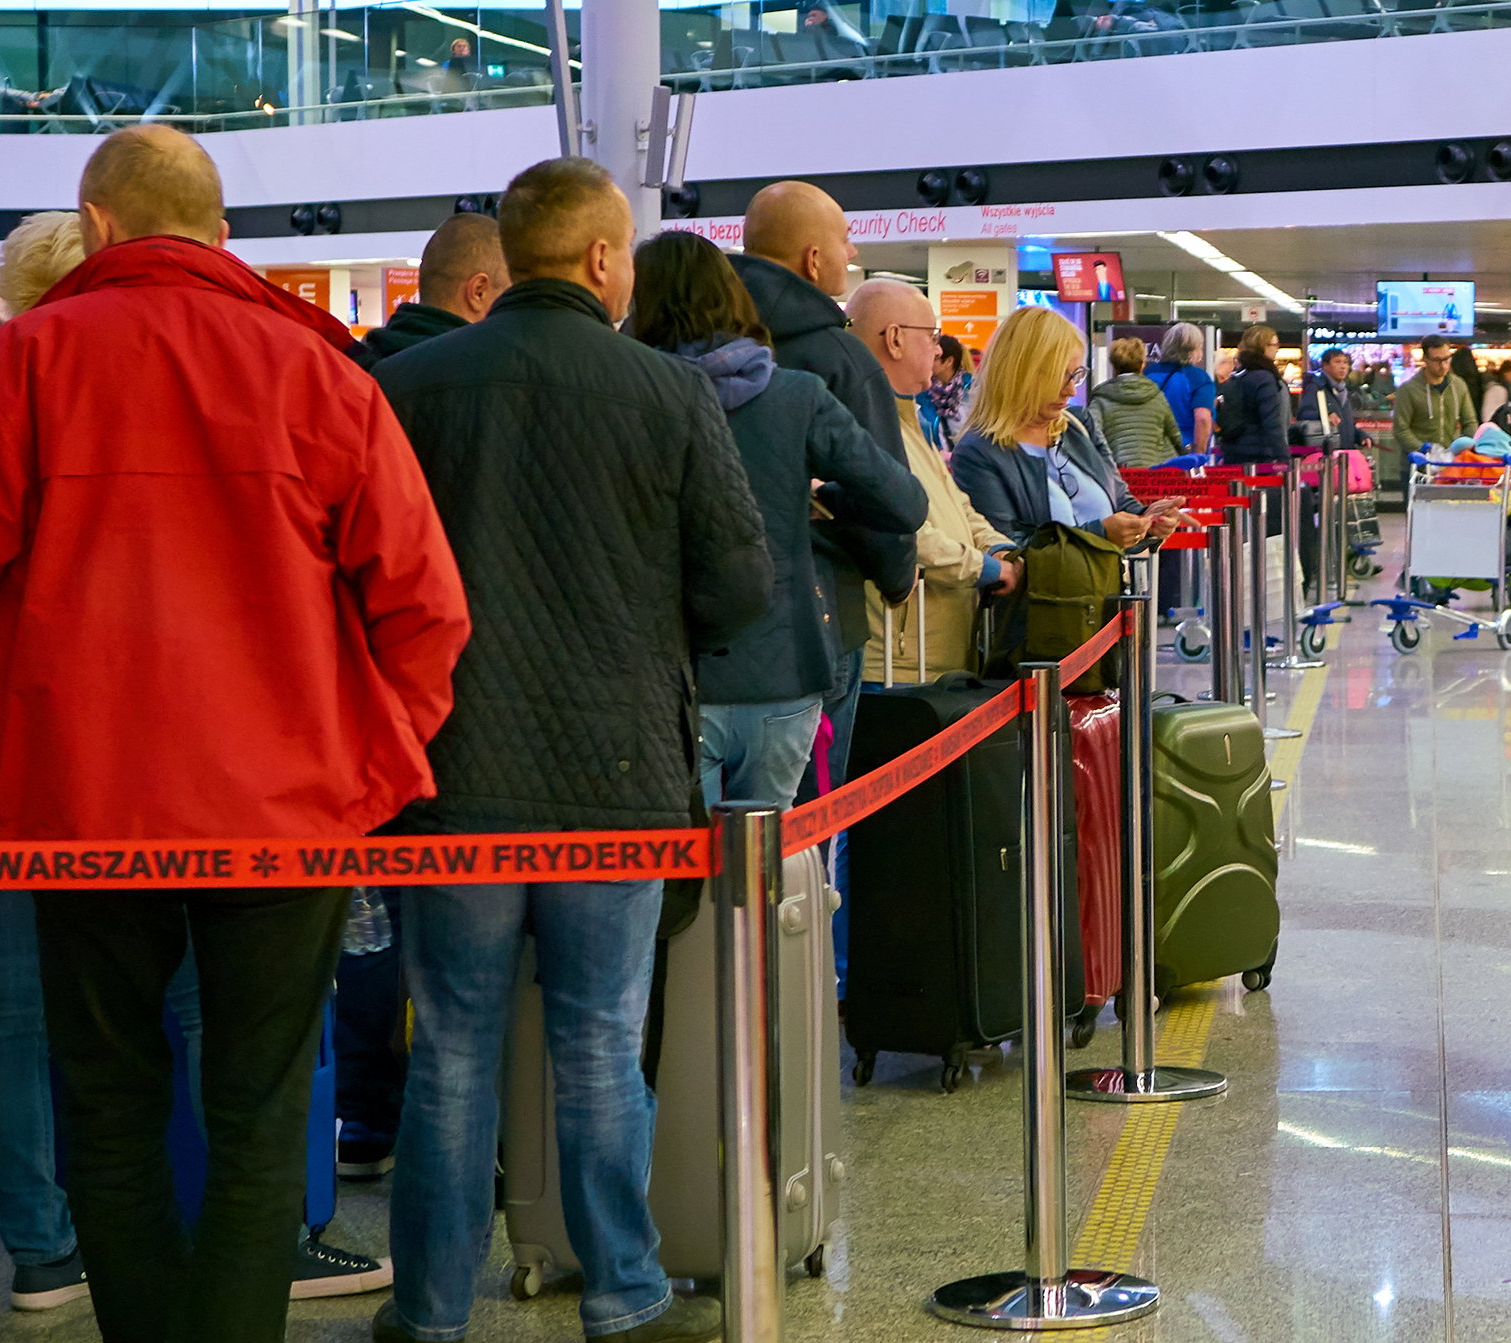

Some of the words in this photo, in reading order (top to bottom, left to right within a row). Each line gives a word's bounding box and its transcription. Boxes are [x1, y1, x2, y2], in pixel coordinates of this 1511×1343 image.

[896, 210, 948, 234] Check
[980, 204, 1021, 220] Wszystkie
[1162, 487, 1209, 496] AIRPORT
[297, 845, 479, 878] WARSAW
[491, 839, 699, 874] FRYDERYK
